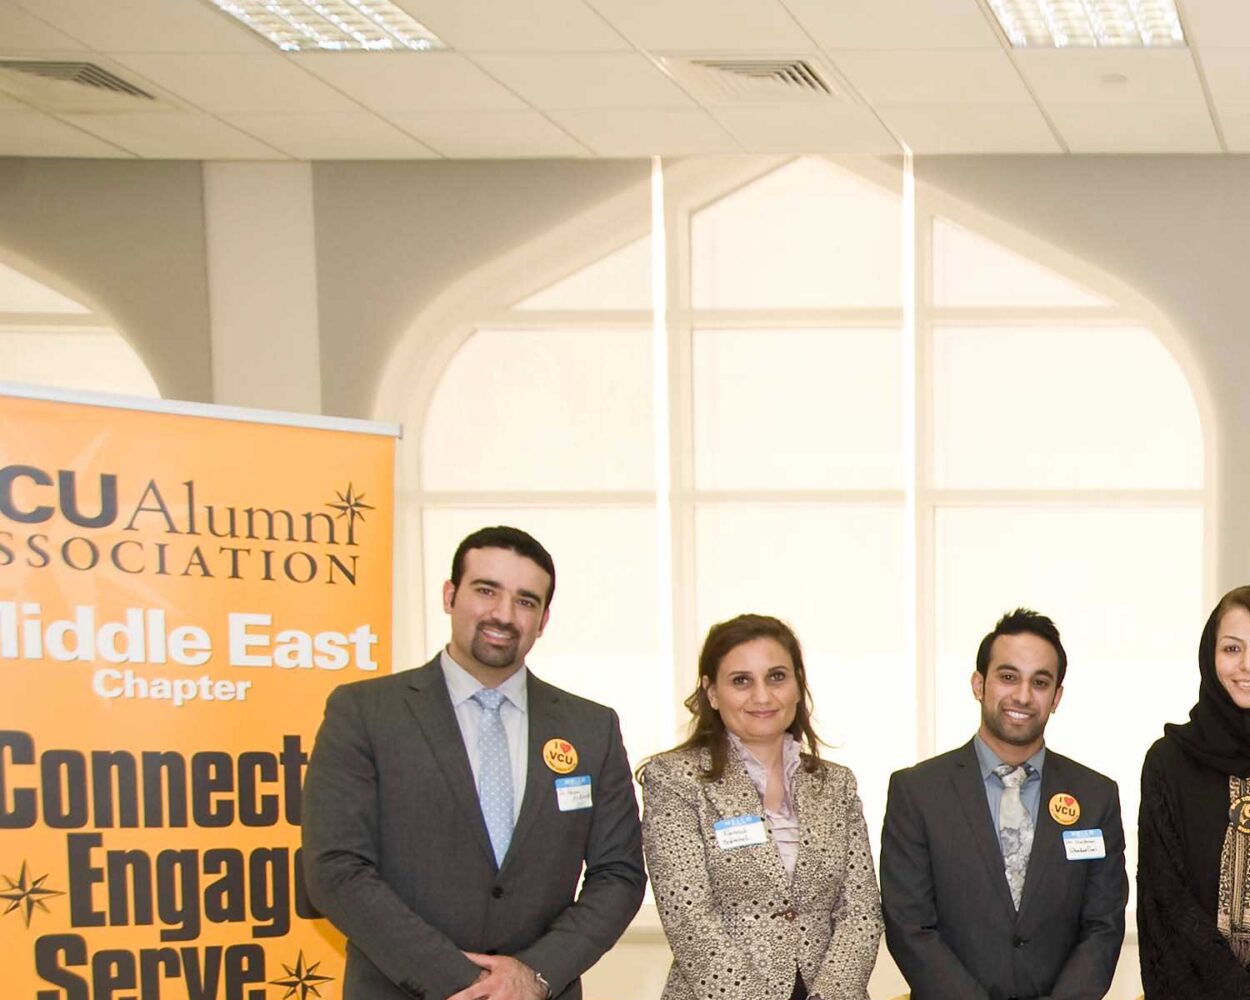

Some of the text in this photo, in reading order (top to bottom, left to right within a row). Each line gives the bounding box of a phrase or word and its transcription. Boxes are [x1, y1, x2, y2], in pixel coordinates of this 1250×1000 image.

[228, 612, 379, 671] East
[93, 668, 252, 707] Chapter
[549, 750, 573, 765] VCU
[0, 730, 308, 830] Connect
[1054, 804, 1076, 817] VCU
